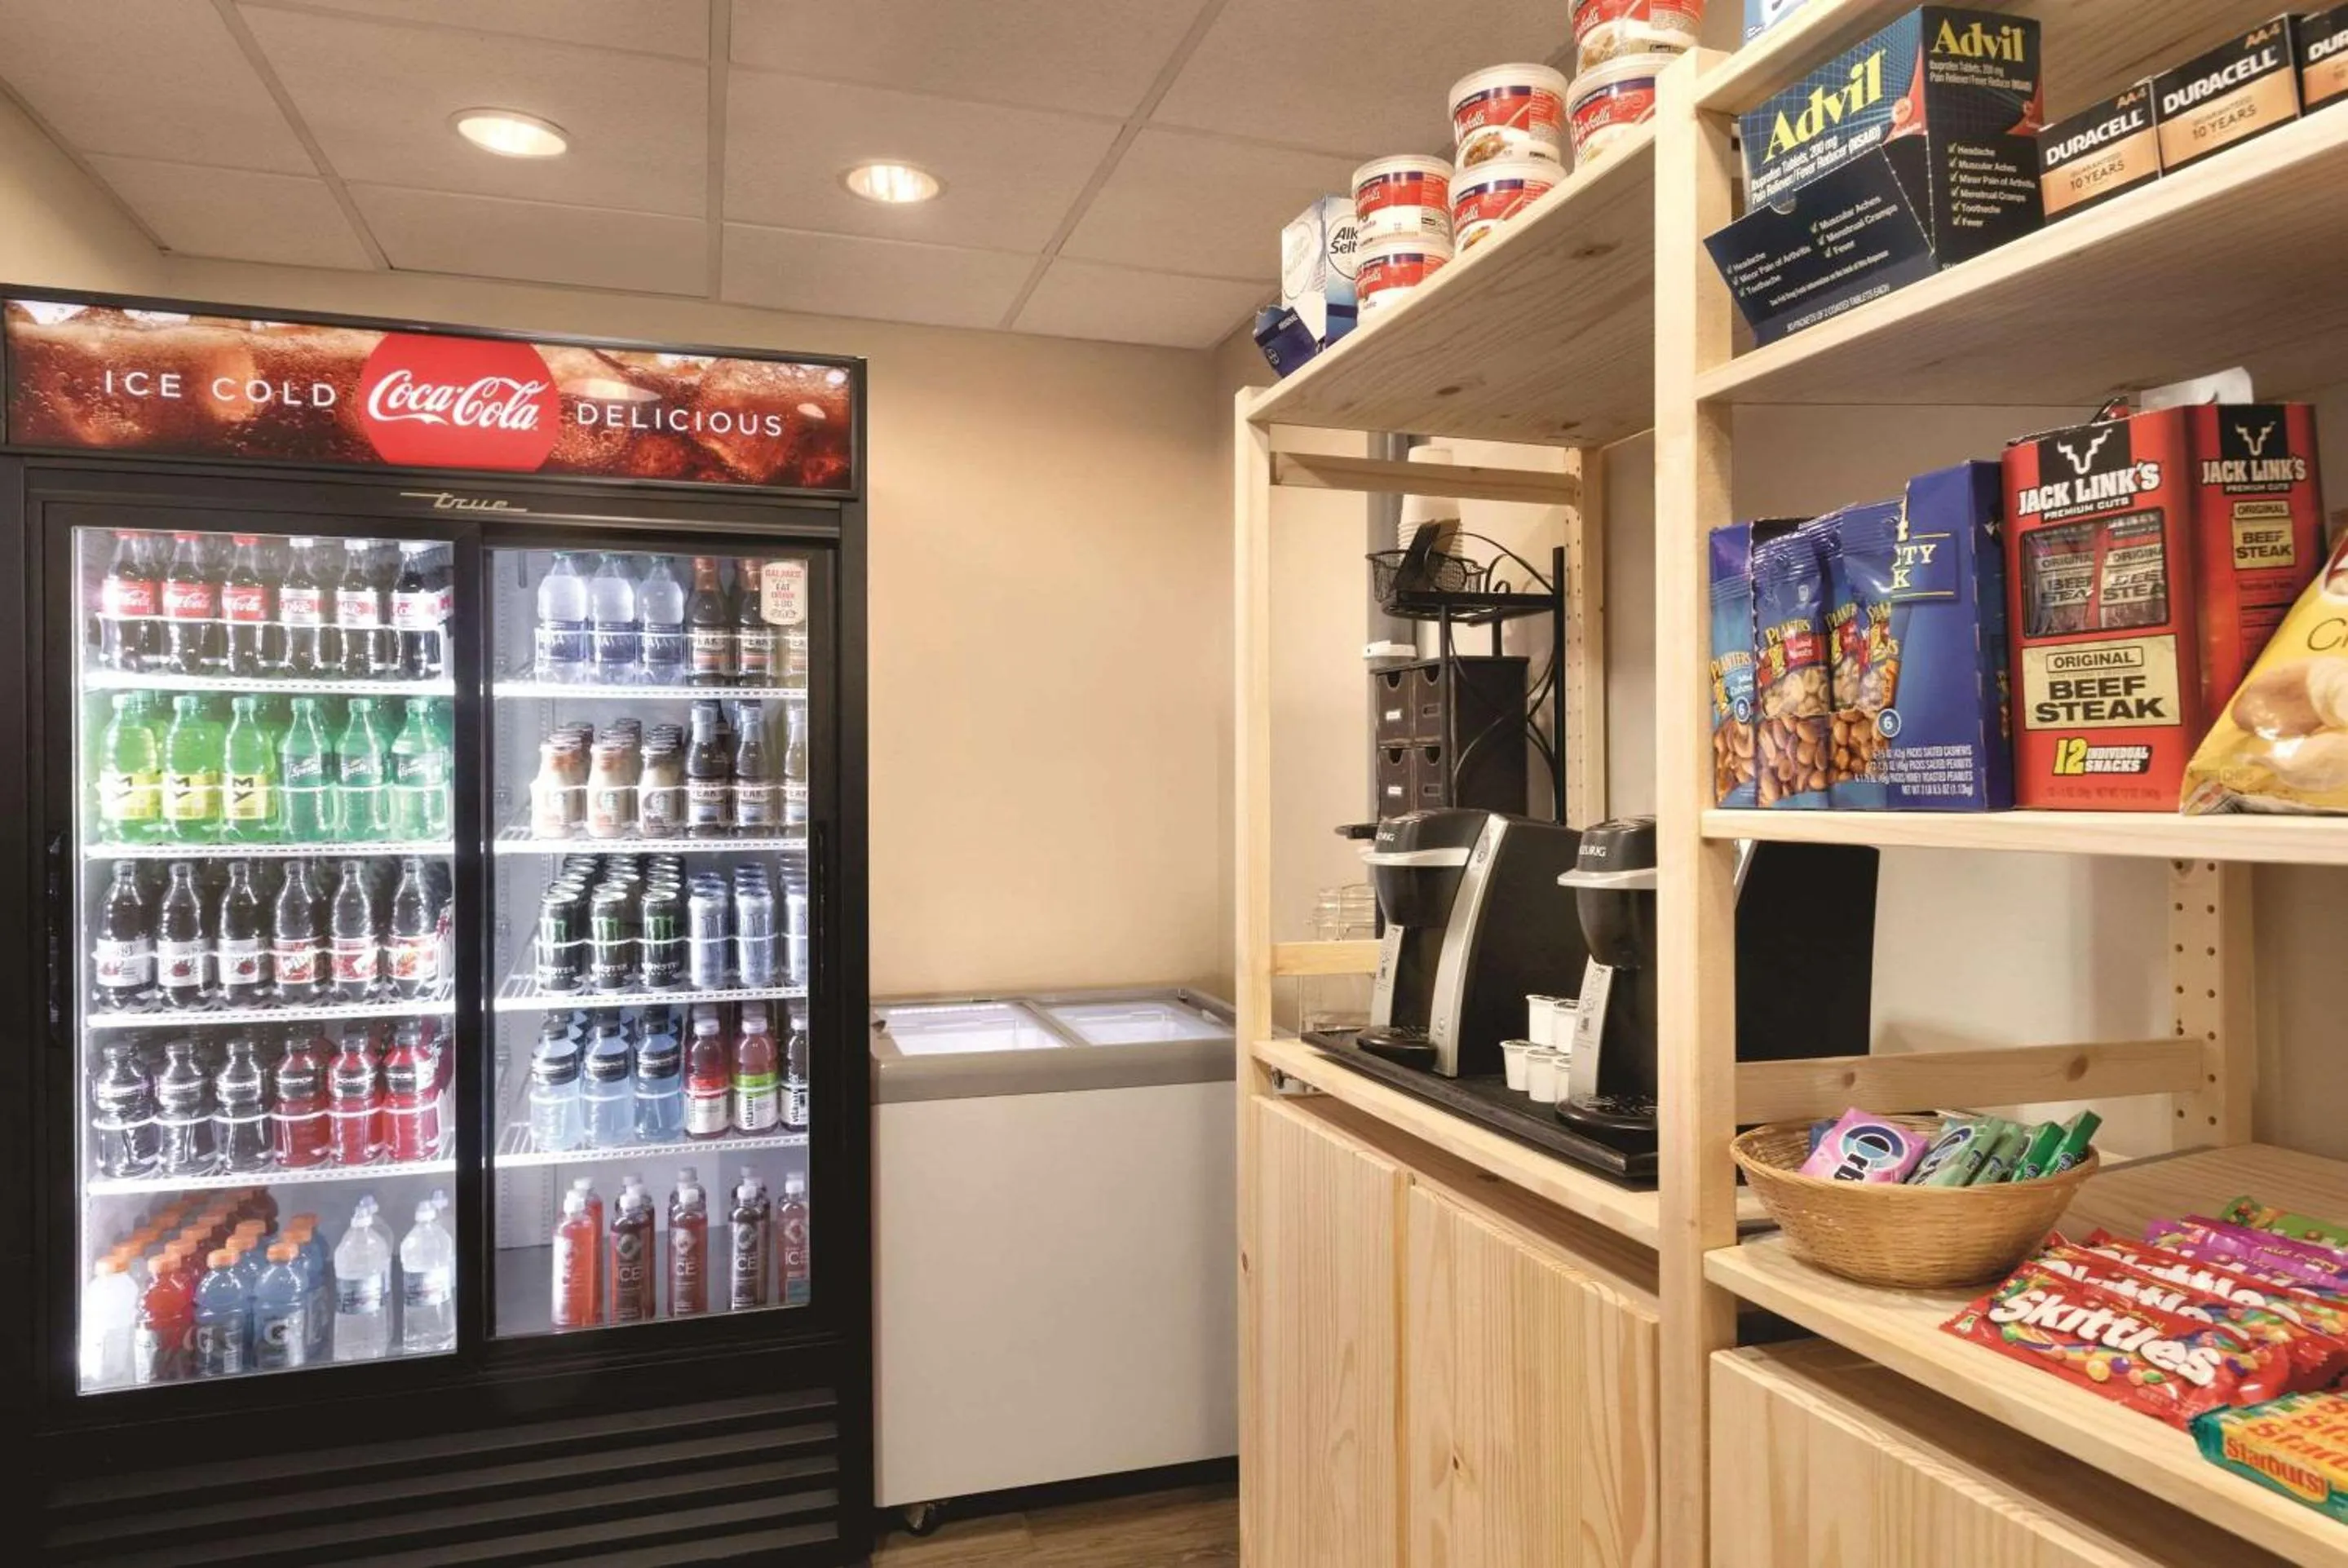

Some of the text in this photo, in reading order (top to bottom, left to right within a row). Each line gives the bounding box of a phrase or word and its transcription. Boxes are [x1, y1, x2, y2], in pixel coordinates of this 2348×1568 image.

[1930, 18, 2025, 62] Advil
[2163, 49, 2278, 115] DURACELL
[1763, 49, 1884, 163] Advil
[2209, 104, 2257, 132] YEARS
[2045, 108, 2145, 166] DURACELL
[2084, 160, 2125, 184] YEARS
[104, 369, 337, 407] ICE COLD
[367, 369, 550, 432] Coca-Cola
[577, 403, 783, 437] DELICIOUS
[2202, 457, 2307, 484] JACK LINK'S
[2019, 461, 2161, 516] JACK LINK'S
[2043, 497, 2129, 520] PREMIUM CUTS
[2237, 504, 2286, 516] ORIGINAL
[2241, 529, 2285, 545] BEEF
[2235, 544, 2293, 559] STEAK
[1765, 618, 1811, 647] PLANTERS
[1710, 651, 1752, 681] PLANTERS
[2054, 652, 2135, 669] ORIGINAL
[2049, 675, 2146, 700] BEEF
[1883, 716, 1893, 730] 6
[2036, 697, 2166, 722] STEAK
[2053, 737, 2088, 775] 12
[2085, 759, 2141, 772] SNACKS
[2087, 745, 2150, 760] INDIVIDUAL
[1988, 1290, 2222, 1387] Skittles
[2226, 1436, 2326, 1499] Starburst
